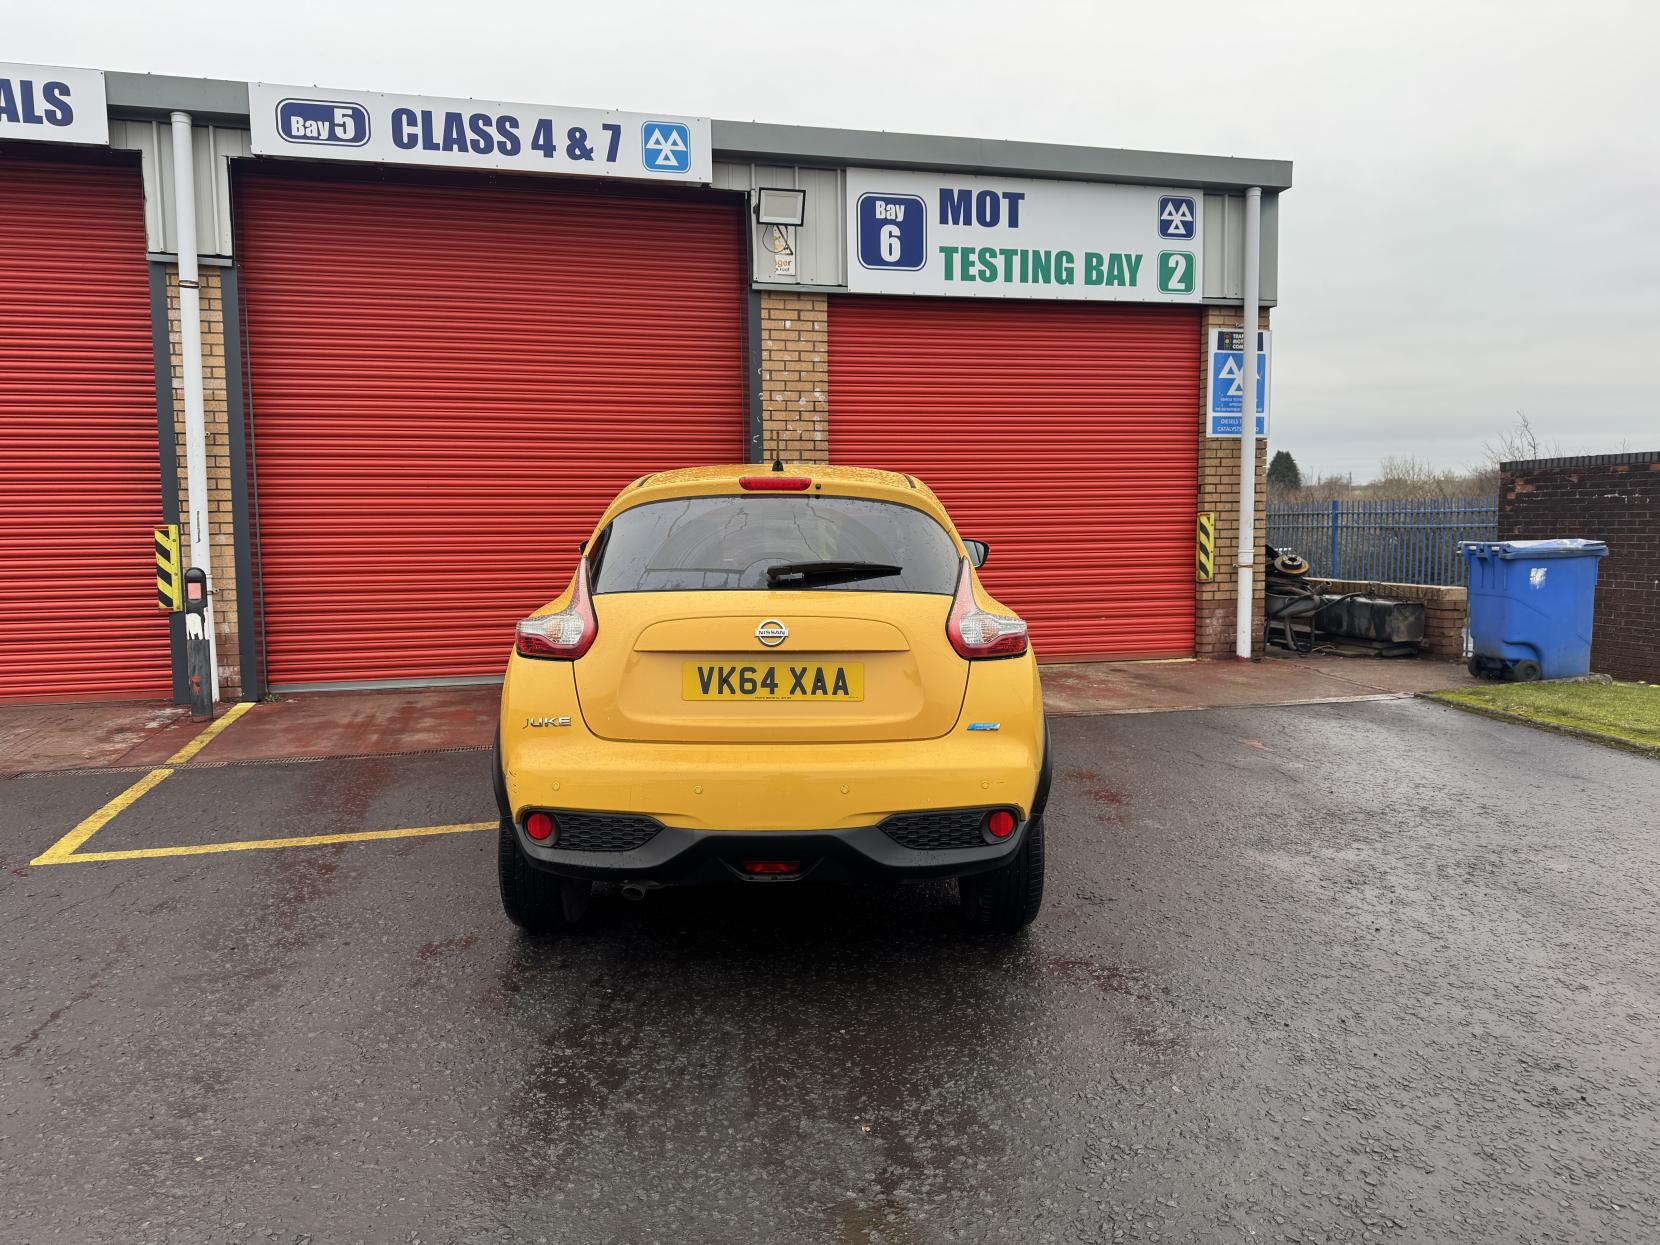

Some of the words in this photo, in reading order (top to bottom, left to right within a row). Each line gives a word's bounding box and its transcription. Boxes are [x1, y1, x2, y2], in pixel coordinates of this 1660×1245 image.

[290, 115, 330, 141] Bay
[333, 107, 356, 140] 5
[391, 107, 522, 157] CLASS
[530, 118, 557, 159] 4
[565, 126, 594, 162] &
[601, 123, 622, 163] 7
[875, 200, 905, 222] Bay
[938, 187, 1026, 229] MOT
[880, 224, 901, 263] 6
[938, 245, 1075, 286] TESTING
[1084, 251, 1144, 288] BAY
[1167, 254, 1187, 290] 2
[697, 666, 779, 695] VK64
[789, 666, 850, 696] XAA
[521, 716, 572, 729] JUKE
